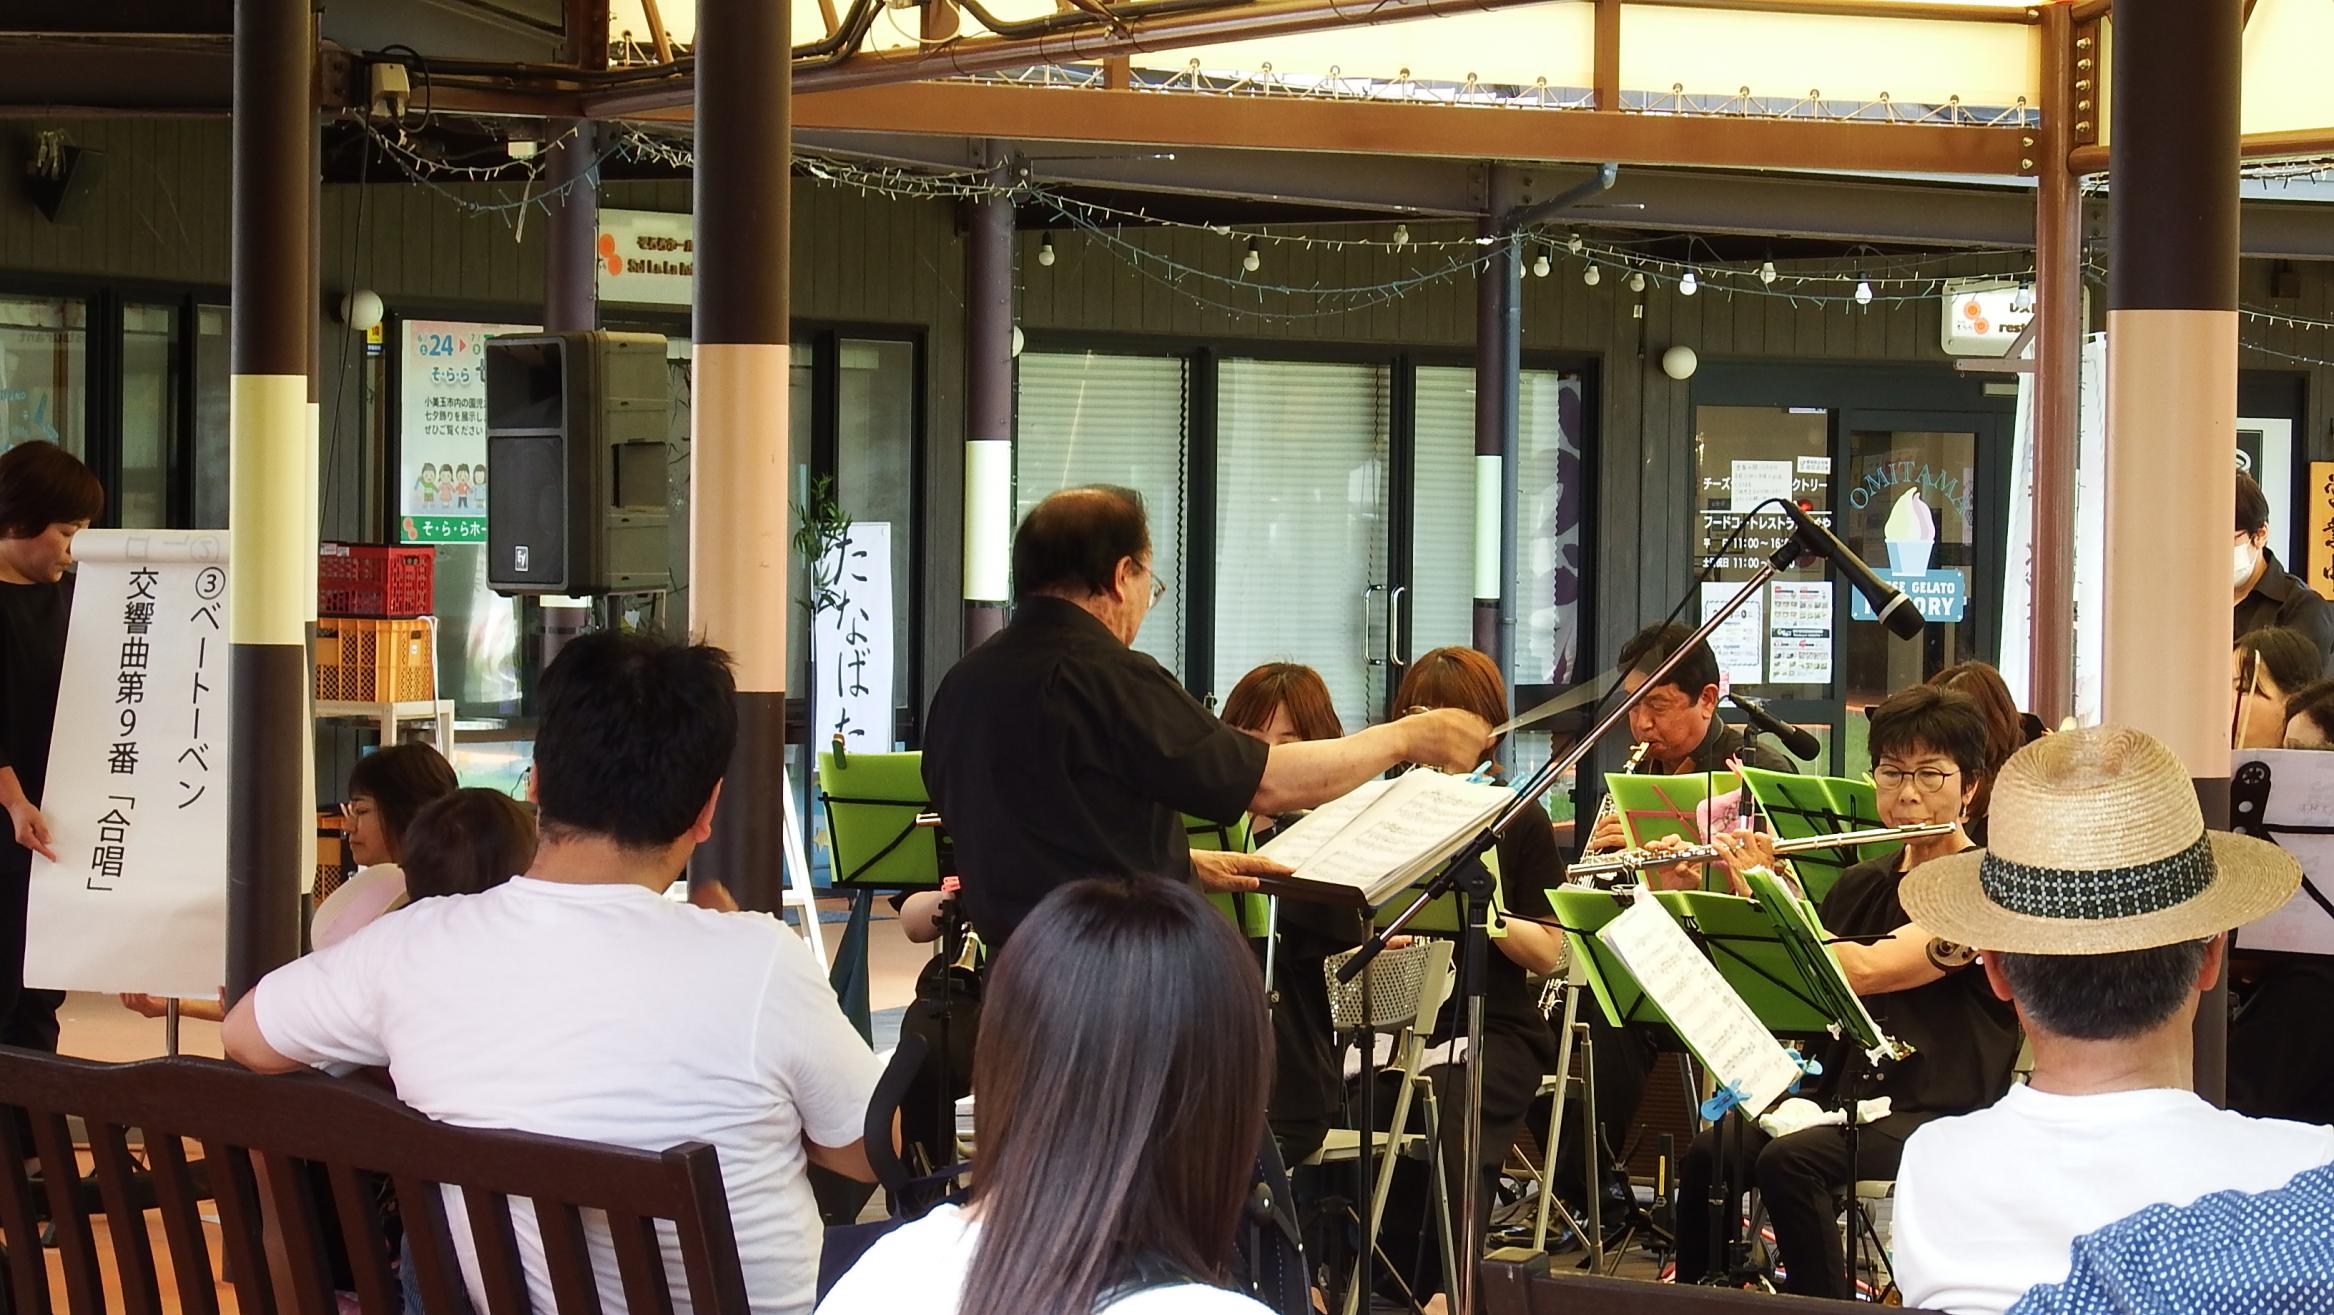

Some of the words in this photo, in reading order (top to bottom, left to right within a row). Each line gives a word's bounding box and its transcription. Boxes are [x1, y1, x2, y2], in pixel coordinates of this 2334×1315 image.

[429, 334, 453, 356] 24
[425, 396, 487, 409] 小美玉市内の園児
[425, 411, 487, 422] 七夕飾りを展示し
[1911, 581, 1956, 594] GELATO
